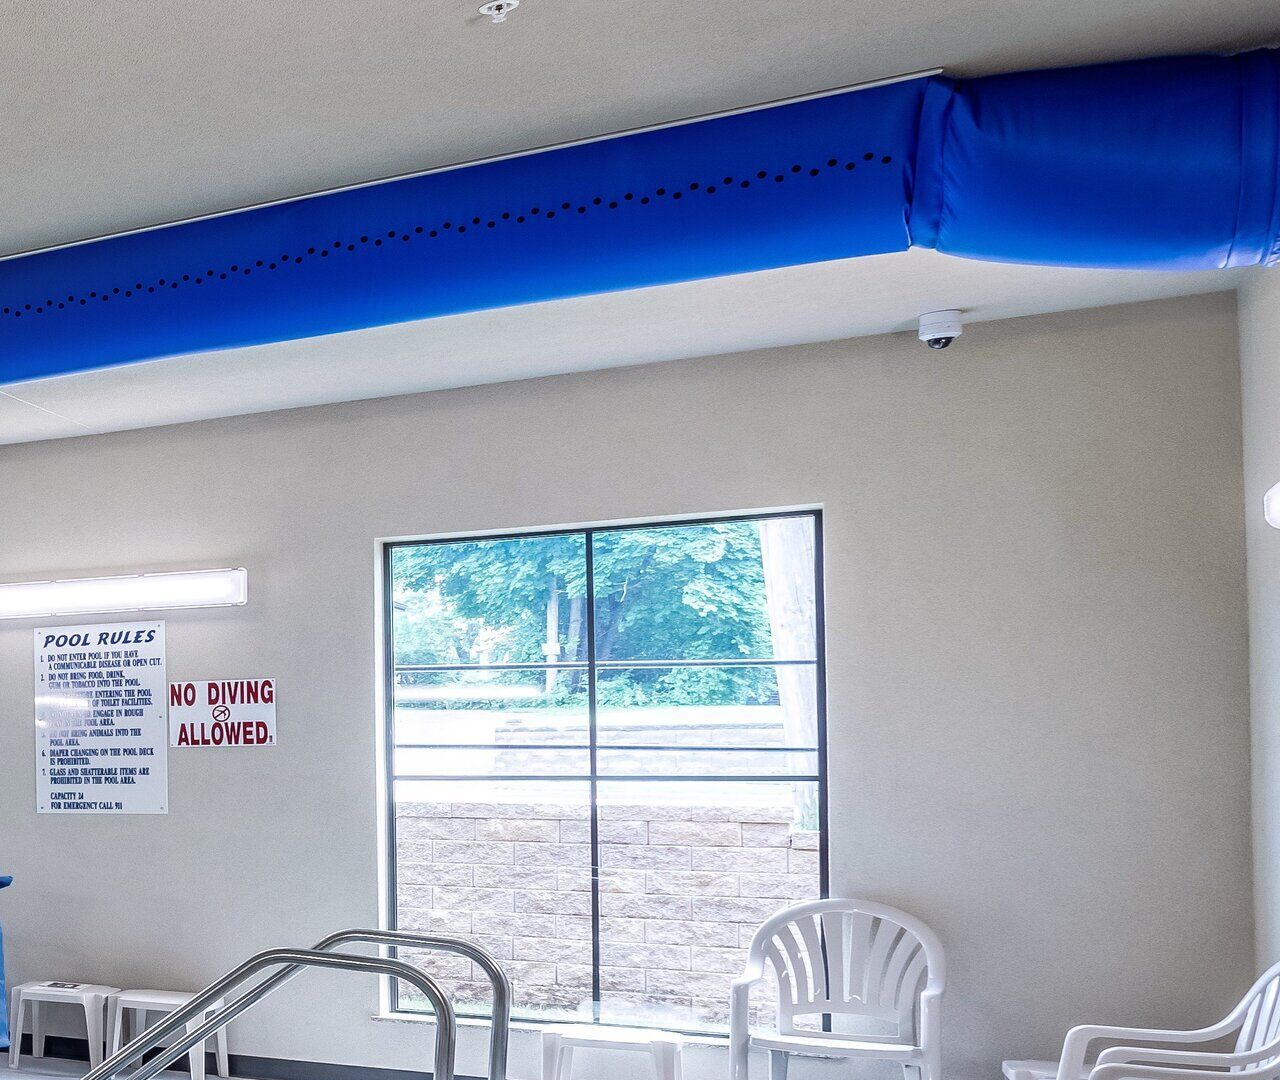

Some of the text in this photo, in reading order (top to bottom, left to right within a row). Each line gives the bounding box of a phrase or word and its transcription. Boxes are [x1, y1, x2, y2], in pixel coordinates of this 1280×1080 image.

[43, 630, 156, 648] POOL RULES
[69, 653, 86, 661] ENTER
[88, 652, 102, 660] POOL
[111, 651, 122, 659] YOU
[124, 650, 138, 658] HAVE
[54, 661, 96, 670] COMMUNICABLE
[99, 660, 121, 668] DISEASE
[123, 659, 130, 667] OR
[132, 659, 147, 667] OPEN
[149, 658, 162, 666] CUT.
[70, 672, 86, 680] BRING
[88, 671, 104, 679] FOOD,
[112, 679, 122, 687] THE
[95, 690, 122, 698] ENTERING
[137, 689, 152, 697] POOL
[170, 679, 274, 706] NO DIVING
[122, 698, 153, 706] FACILITIES.
[124, 709, 144, 717] ROUGH
[89, 729, 113, 737] ANIMALS
[177, 720, 269, 746] ALLOWED
[50, 749, 69, 757] DIAPER
[100, 748, 108, 756] ON
[110, 748, 120, 756] THE
[122, 748, 137, 756] POOL
[57, 758, 91, 766] PROHIBITED.
[50, 768, 66, 776] GLASS
[51, 792, 76, 800] CAPACITY
